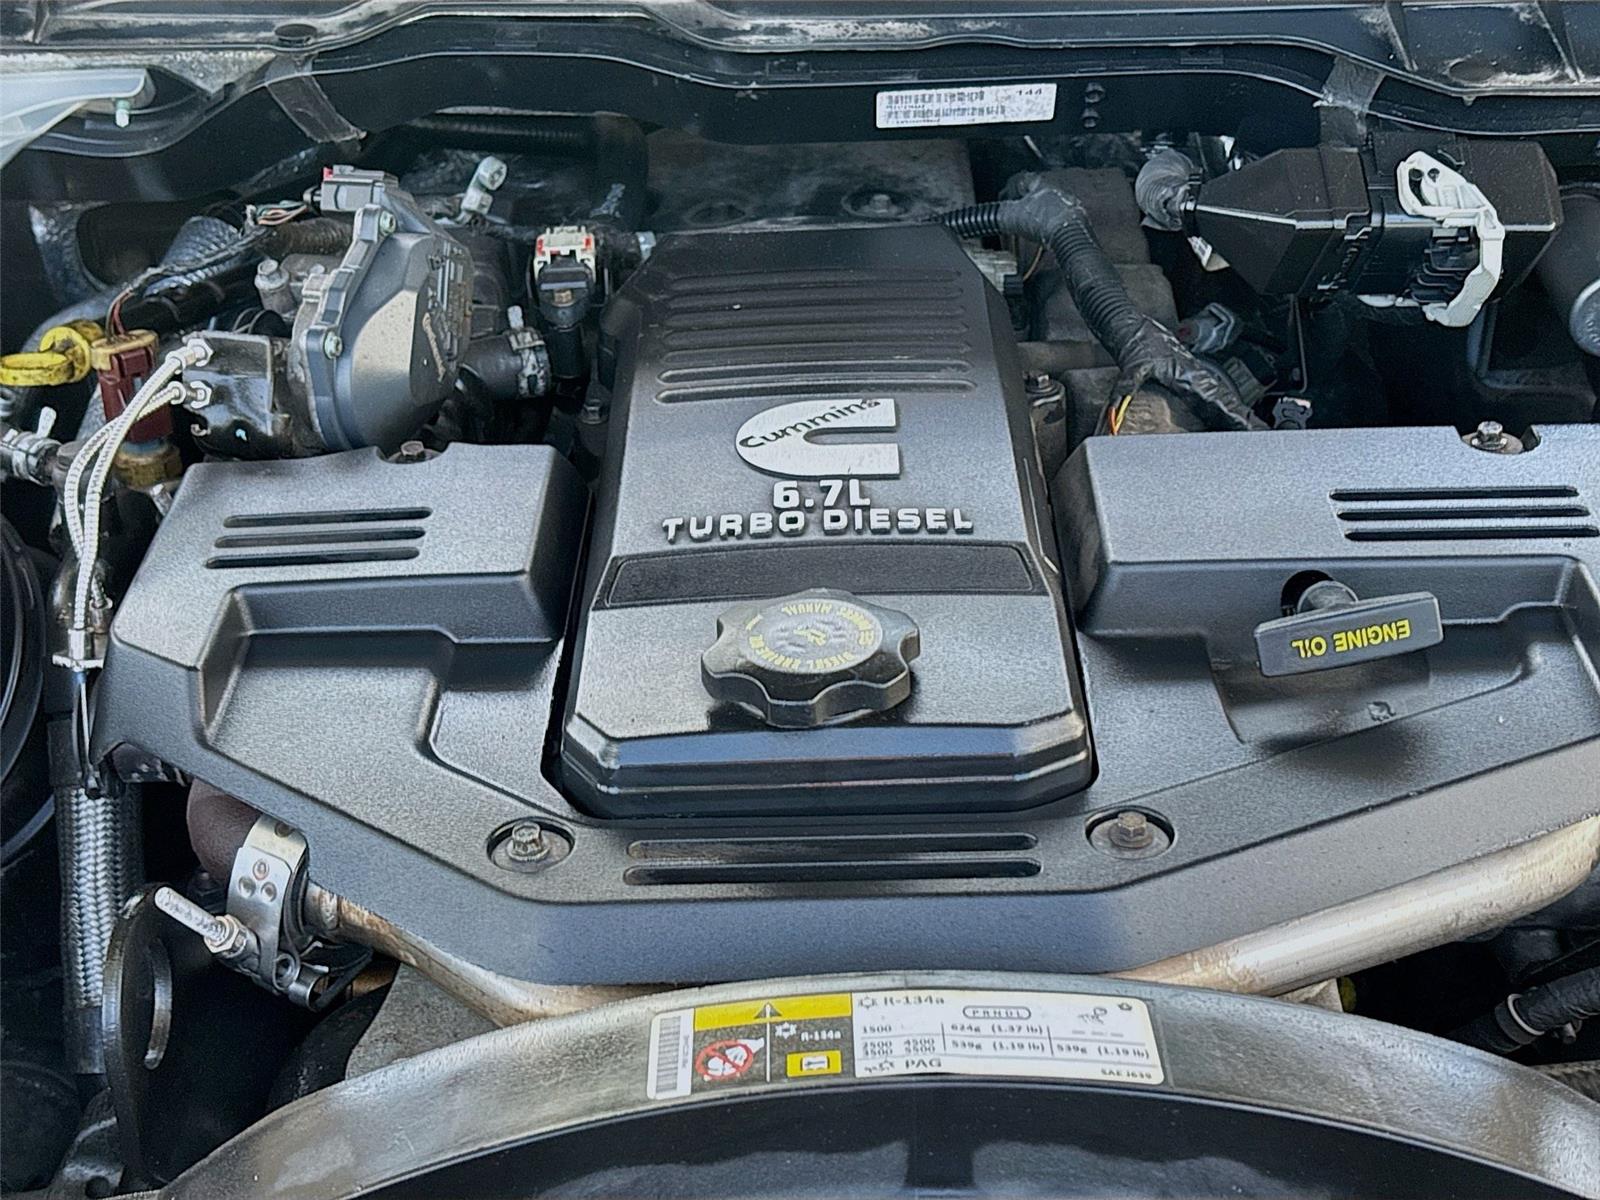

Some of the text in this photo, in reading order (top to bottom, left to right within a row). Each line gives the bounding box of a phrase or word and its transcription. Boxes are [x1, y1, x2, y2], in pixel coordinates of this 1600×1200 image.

[738, 397, 882, 449] Cummins
[771, 479, 872, 509] 6.7L
[662, 507, 974, 542] TURBO DIESEL
[1291, 618, 1412, 658] ENGINE OIL
[883, 995, 946, 1007] R-134a
[904, 1058, 943, 1070] PAG
